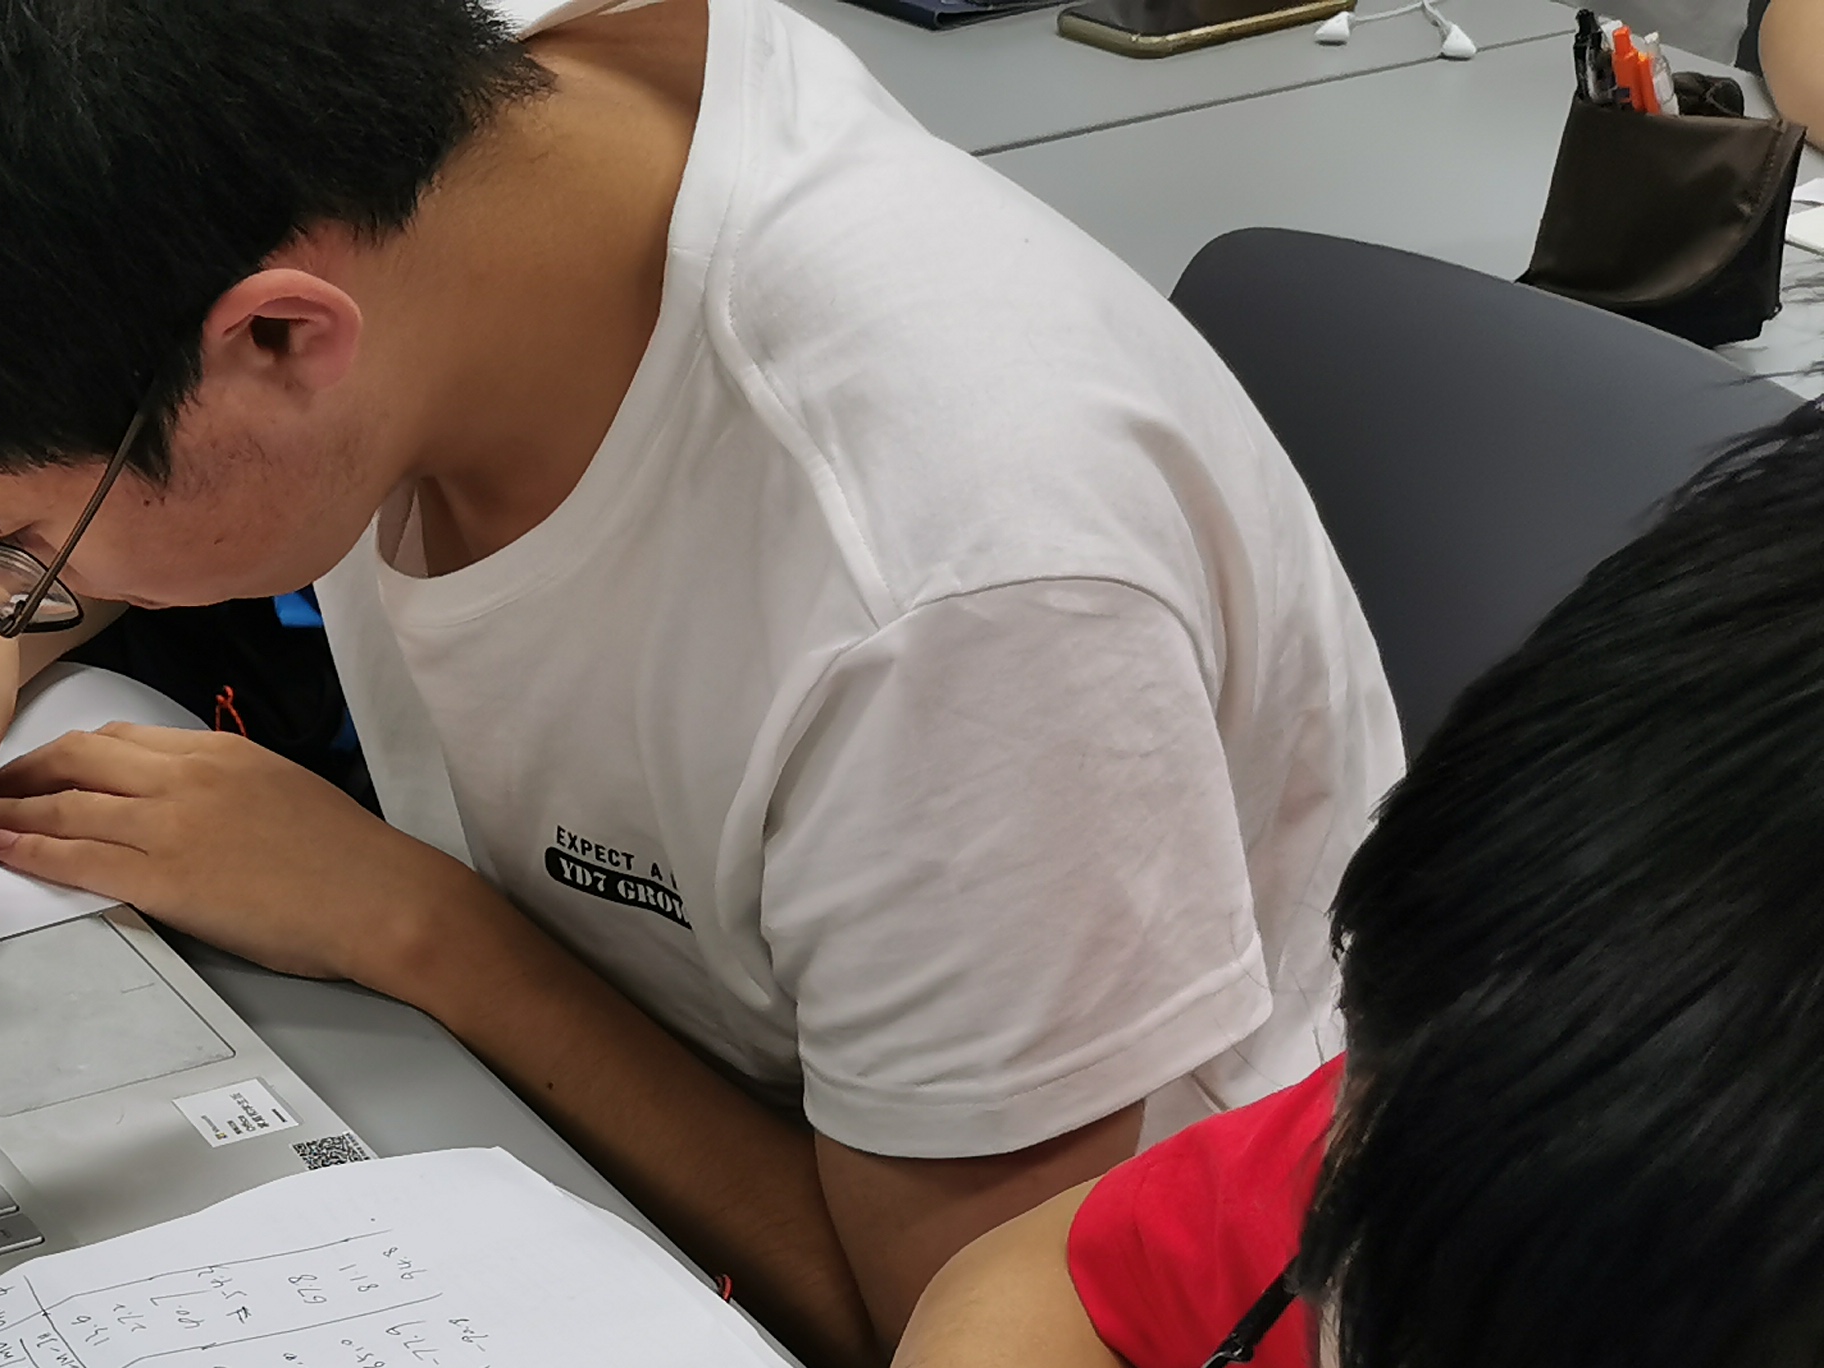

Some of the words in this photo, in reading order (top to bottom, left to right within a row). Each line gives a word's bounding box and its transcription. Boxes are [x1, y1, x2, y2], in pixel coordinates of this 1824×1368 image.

[556, 825, 635, 871] EXPECT
[650, 861, 663, 882] A
[558, 857, 607, 893] YD7
